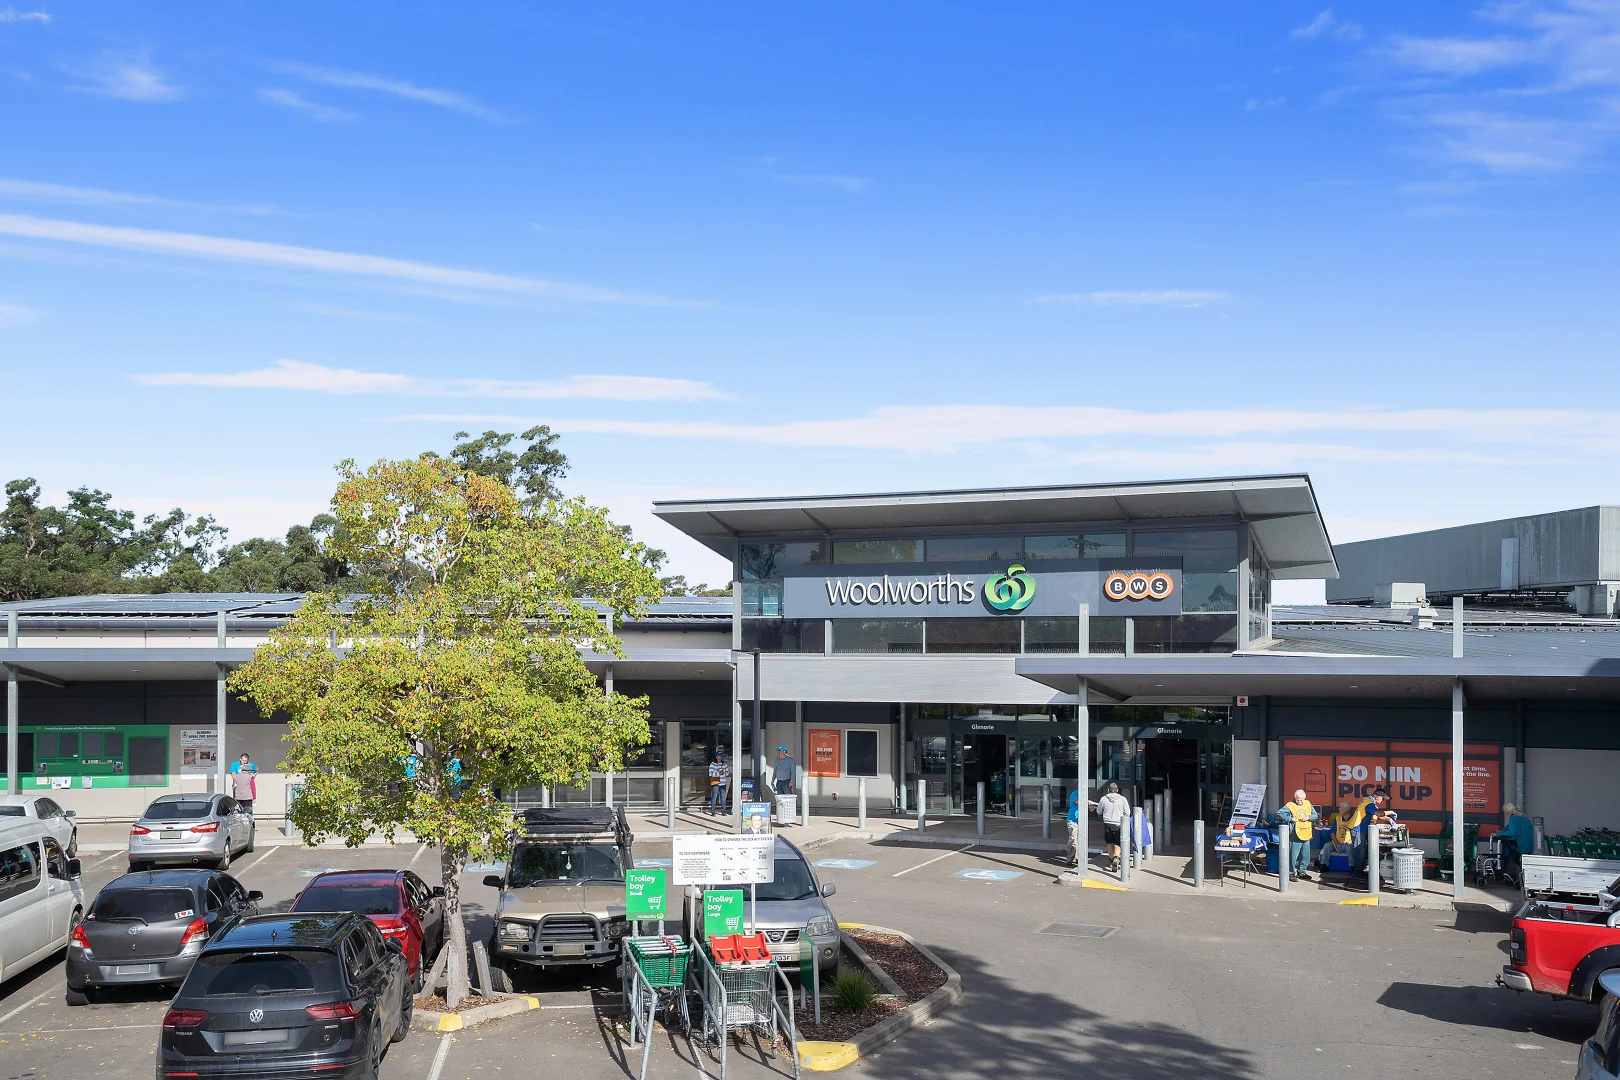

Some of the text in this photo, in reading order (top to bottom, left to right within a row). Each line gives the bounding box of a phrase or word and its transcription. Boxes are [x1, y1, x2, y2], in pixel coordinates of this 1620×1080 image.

[825, 574, 976, 604] Woolworths
[971, 723, 995, 731] Glenorie
[1156, 726, 1183, 735] Glenorie
[1337, 764, 1420, 782] 30 MIN
[1400, 784, 1432, 802] UP
[629, 874, 656, 884] Trolley
[630, 882, 644, 891] bay
[707, 895, 734, 904] Trolley
[708, 903, 722, 912] bay
